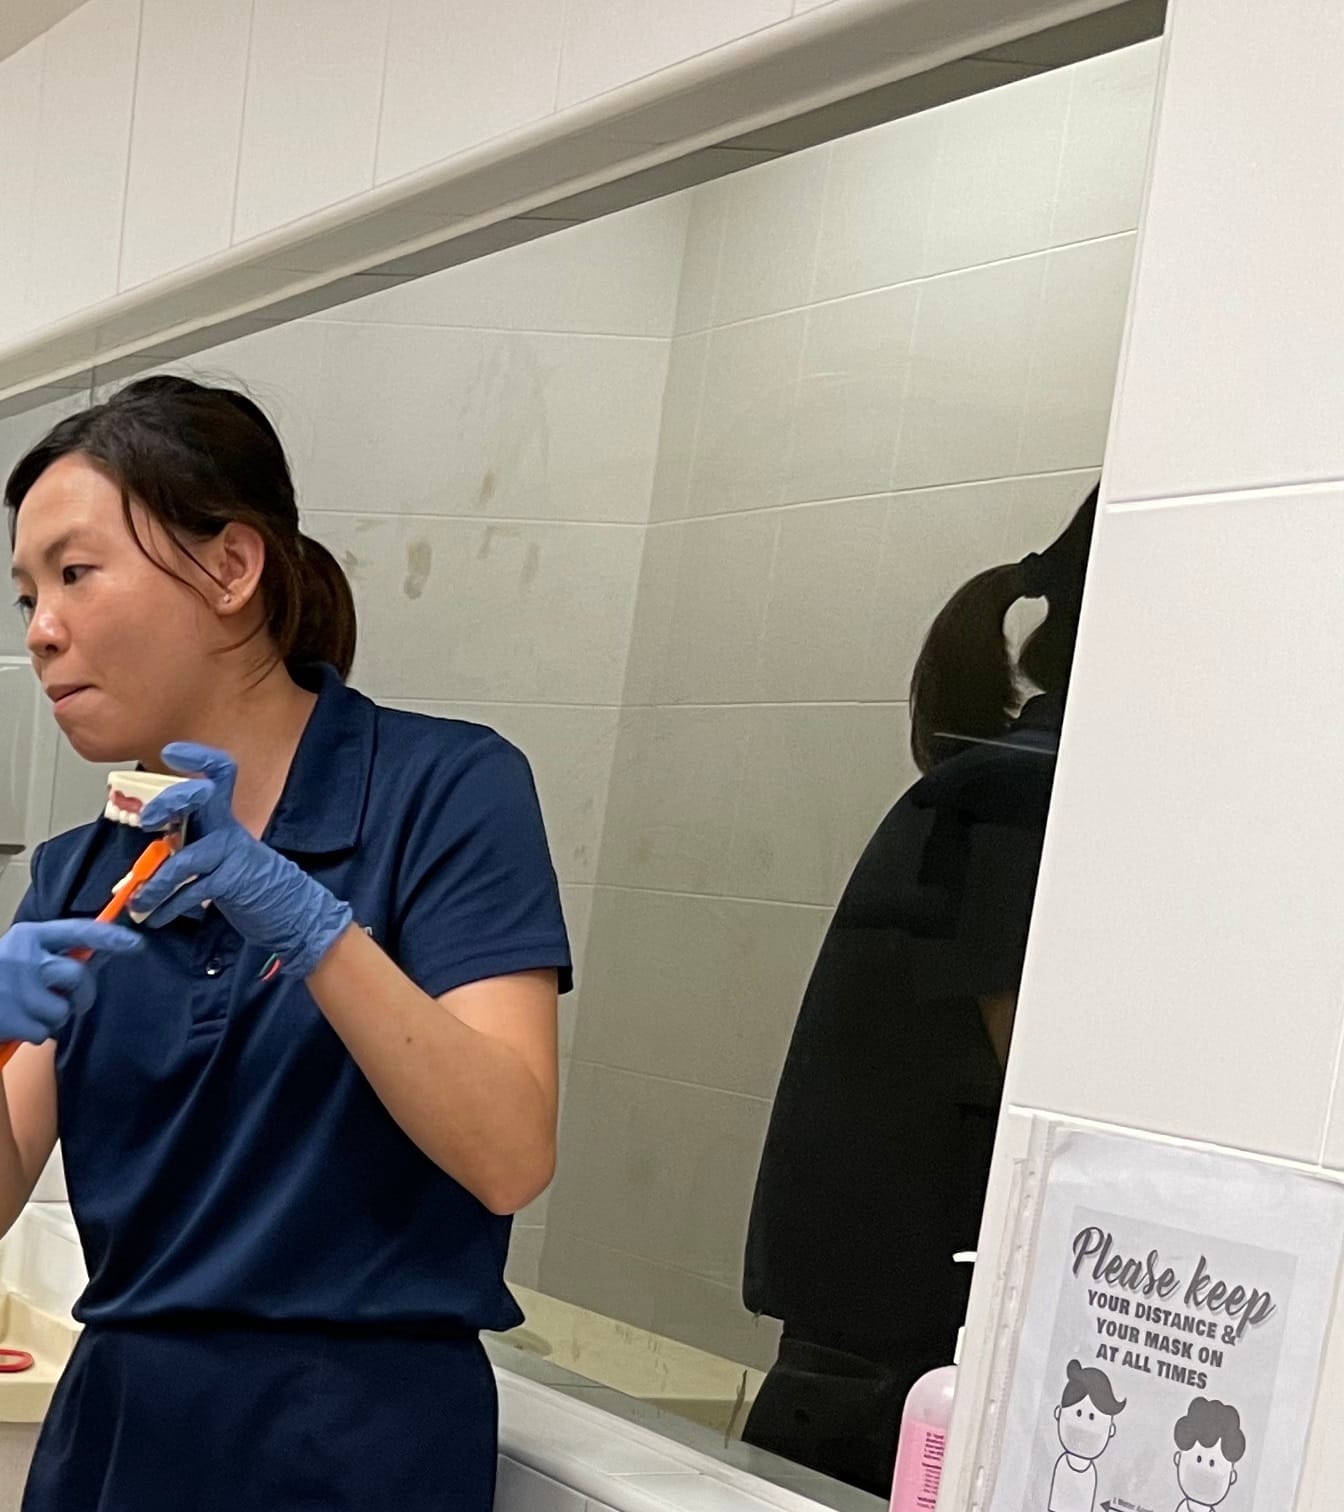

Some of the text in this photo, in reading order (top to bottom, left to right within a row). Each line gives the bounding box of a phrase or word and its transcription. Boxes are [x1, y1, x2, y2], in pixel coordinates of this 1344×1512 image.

[1072, 1226, 1277, 1339] Please keep
[1088, 1288, 1236, 1346] YOUR DISTANCE &
[1096, 1317, 1224, 1368] YOUR MASK ON
[1095, 1343, 1208, 1390] AT ALL TIMES
